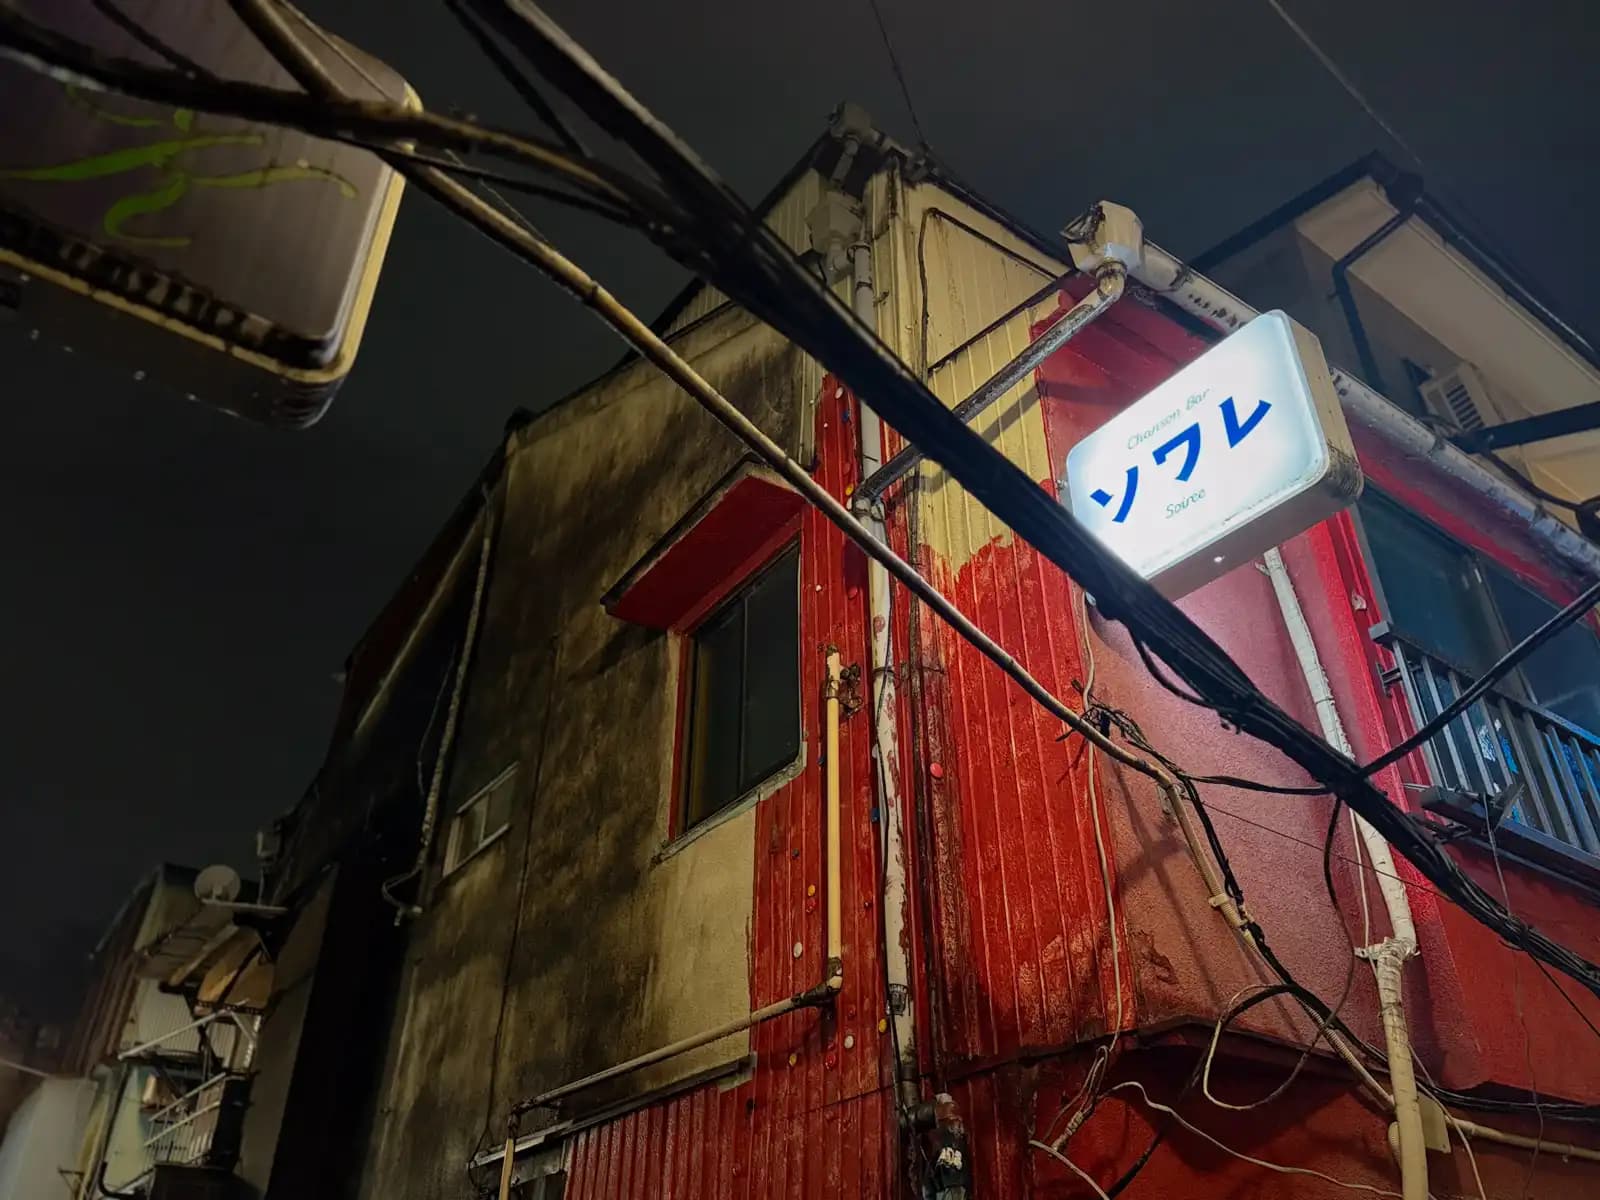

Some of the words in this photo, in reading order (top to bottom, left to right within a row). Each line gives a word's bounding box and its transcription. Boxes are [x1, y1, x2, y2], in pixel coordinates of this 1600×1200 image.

[1090, 396, 1272, 523] ソワレ
[1126, 408, 1181, 450] Chanson
[1186, 387, 1210, 410] Bar
